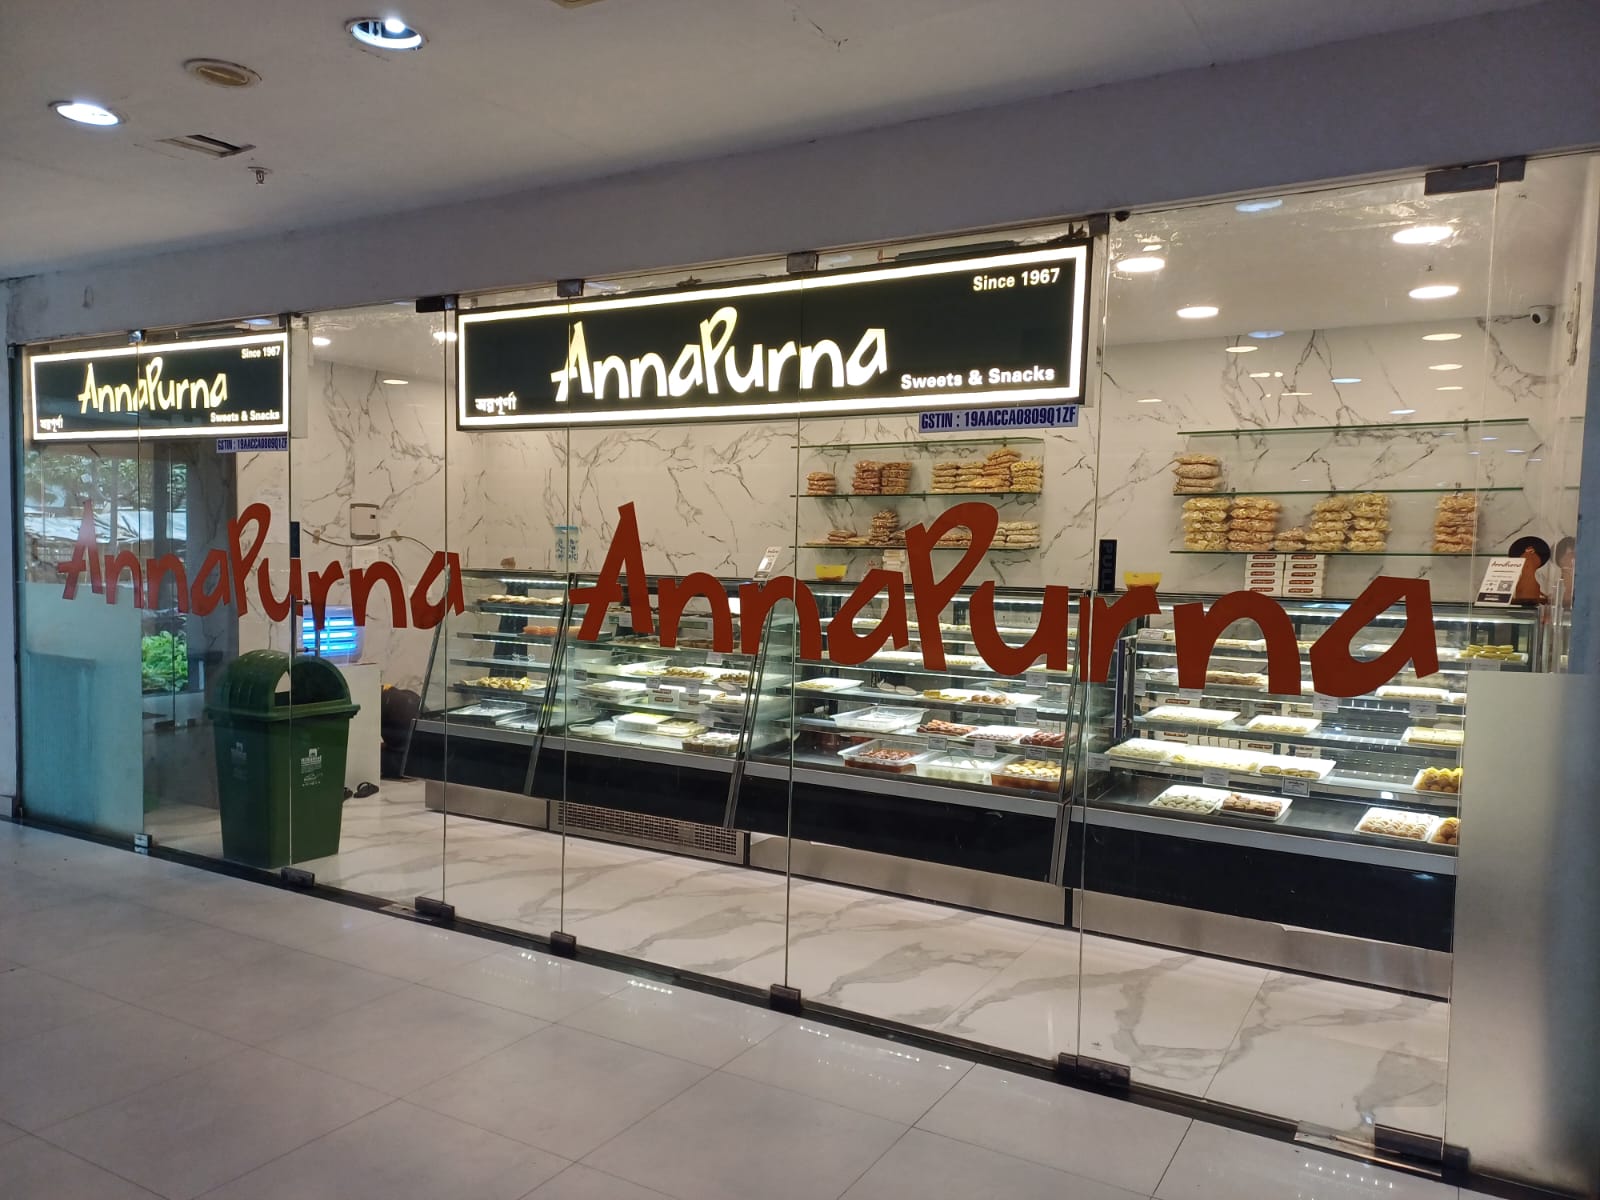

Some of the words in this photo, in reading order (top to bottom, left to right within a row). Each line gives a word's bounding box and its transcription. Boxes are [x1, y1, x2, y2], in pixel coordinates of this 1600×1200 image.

[972, 274, 1015, 291] Since
[1021, 268, 1060, 287] 1967
[241, 349, 261, 359] Since
[263, 346, 281, 357] 1967
[550, 306, 888, 402] AnnaPurna
[78, 356, 228, 414] AnnaPurna
[900, 373, 962, 390] Sweets
[968, 370, 983, 386] &
[988, 366, 1055, 385] Snacks
[210, 412, 239, 422] Sweets
[241, 410, 248, 421] &
[250, 410, 280, 421] Snacks
[921, 412, 953, 430] GSTIN
[964, 407, 1077, 427] 19AACCA0809Q1ZF
[58, 498, 465, 630] AnnaPurna
[1102, 542, 1113, 590] PULL
[569, 500, 1440, 698] AnnaPurna
